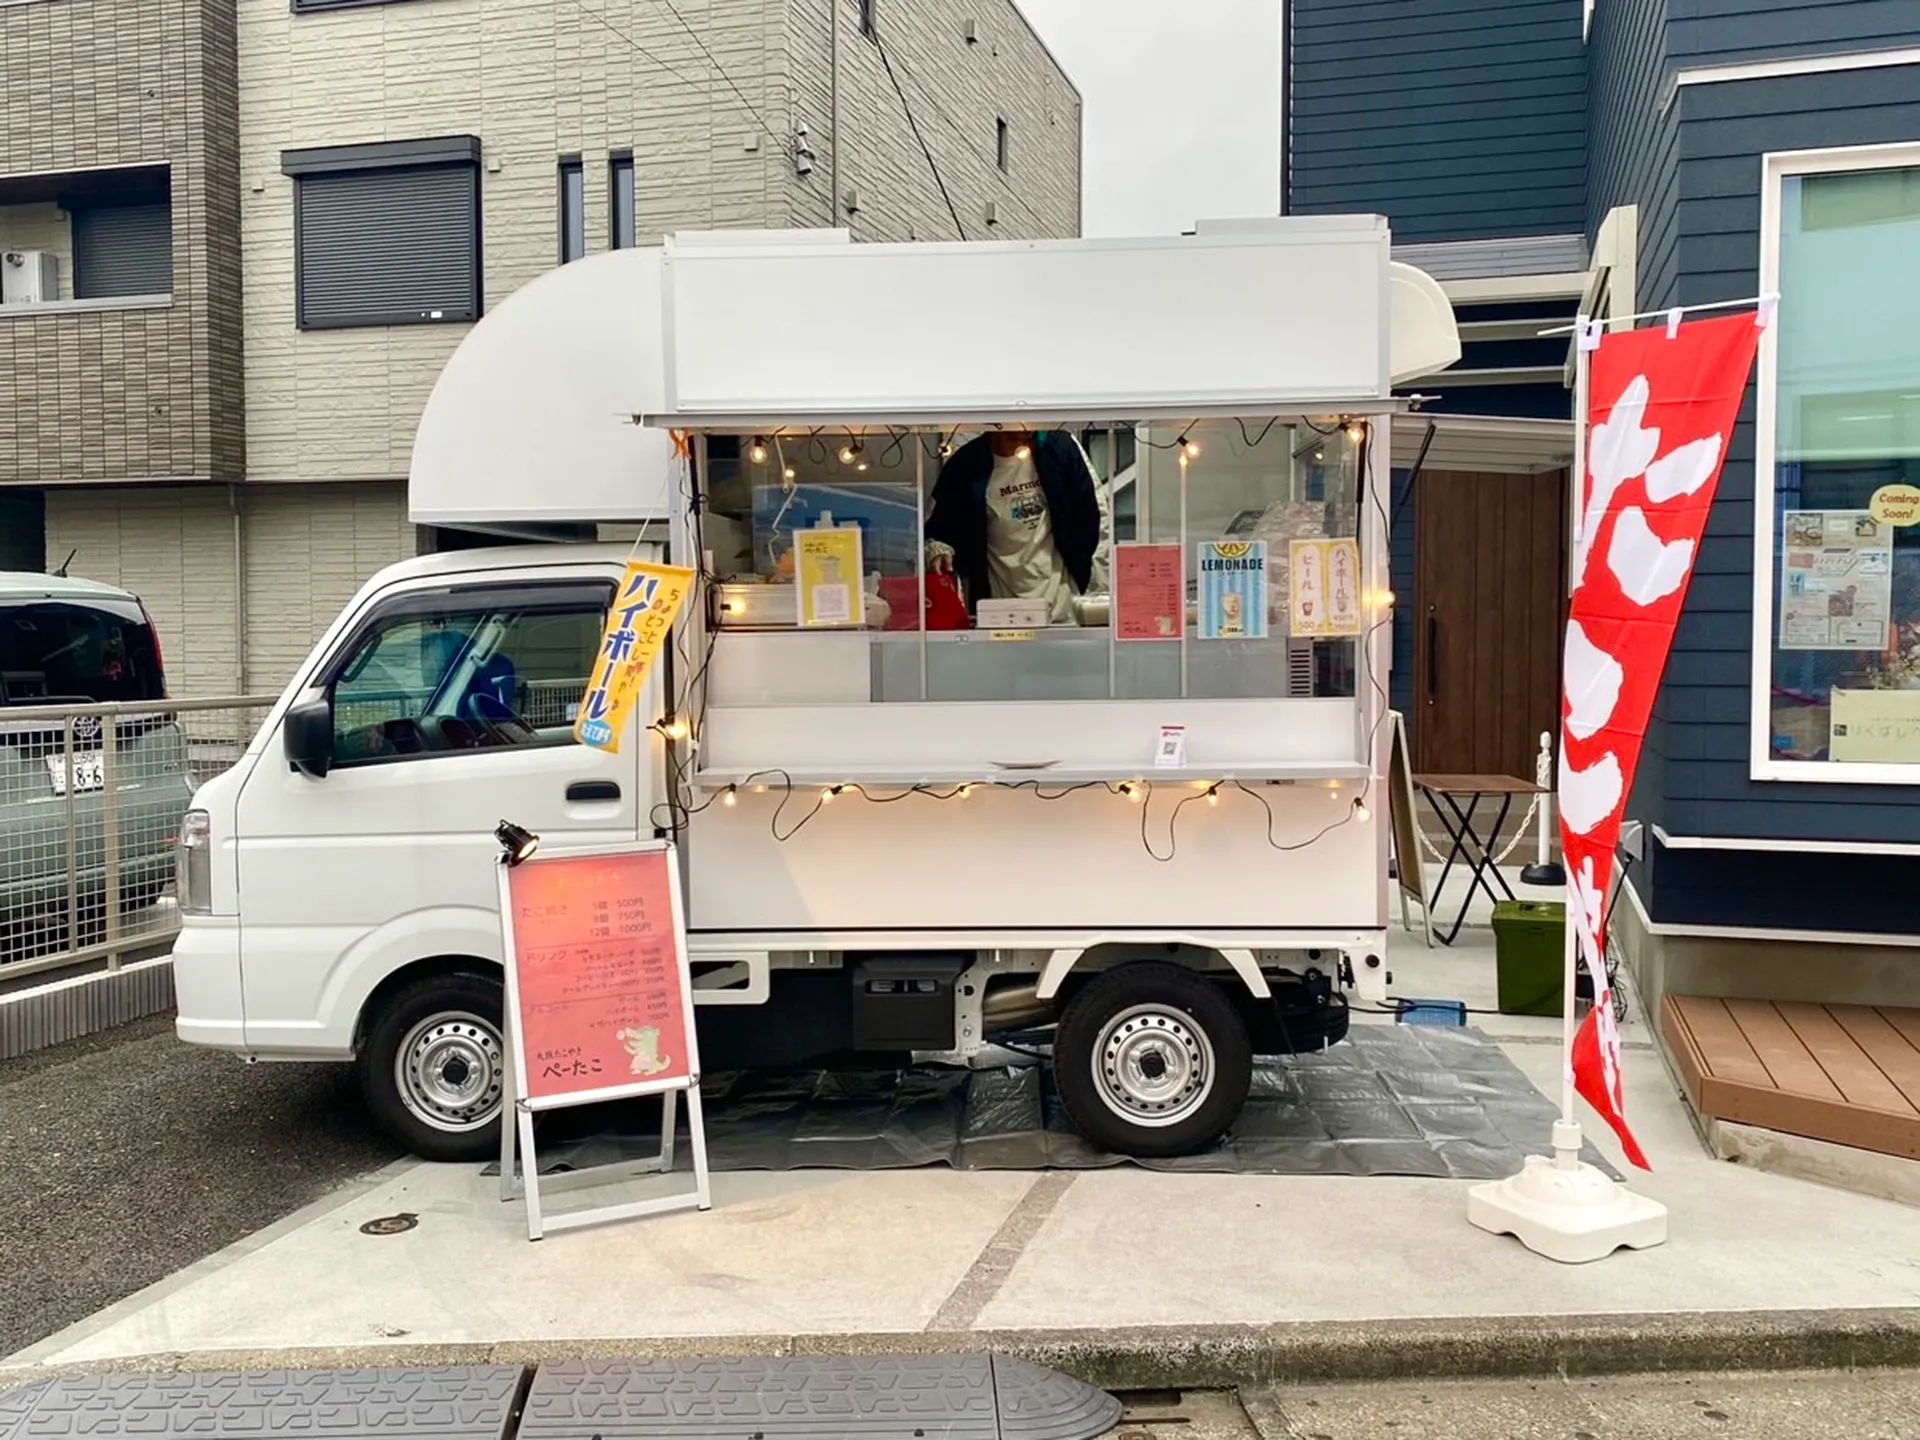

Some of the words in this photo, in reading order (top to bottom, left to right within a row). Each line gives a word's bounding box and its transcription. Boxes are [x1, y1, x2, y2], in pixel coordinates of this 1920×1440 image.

[1000, 480, 1041, 497] Marmo
[1879, 492, 1919, 505] Coming
[1882, 508, 1915, 519] Soon!
[1202, 558, 1263, 571] LEMONADE
[1302, 555, 1315, 590] ビール
[1335, 548, 1349, 600] ハイボール
[583, 573, 659, 721] ハイボール
[526, 949, 567, 962] ドリンク
